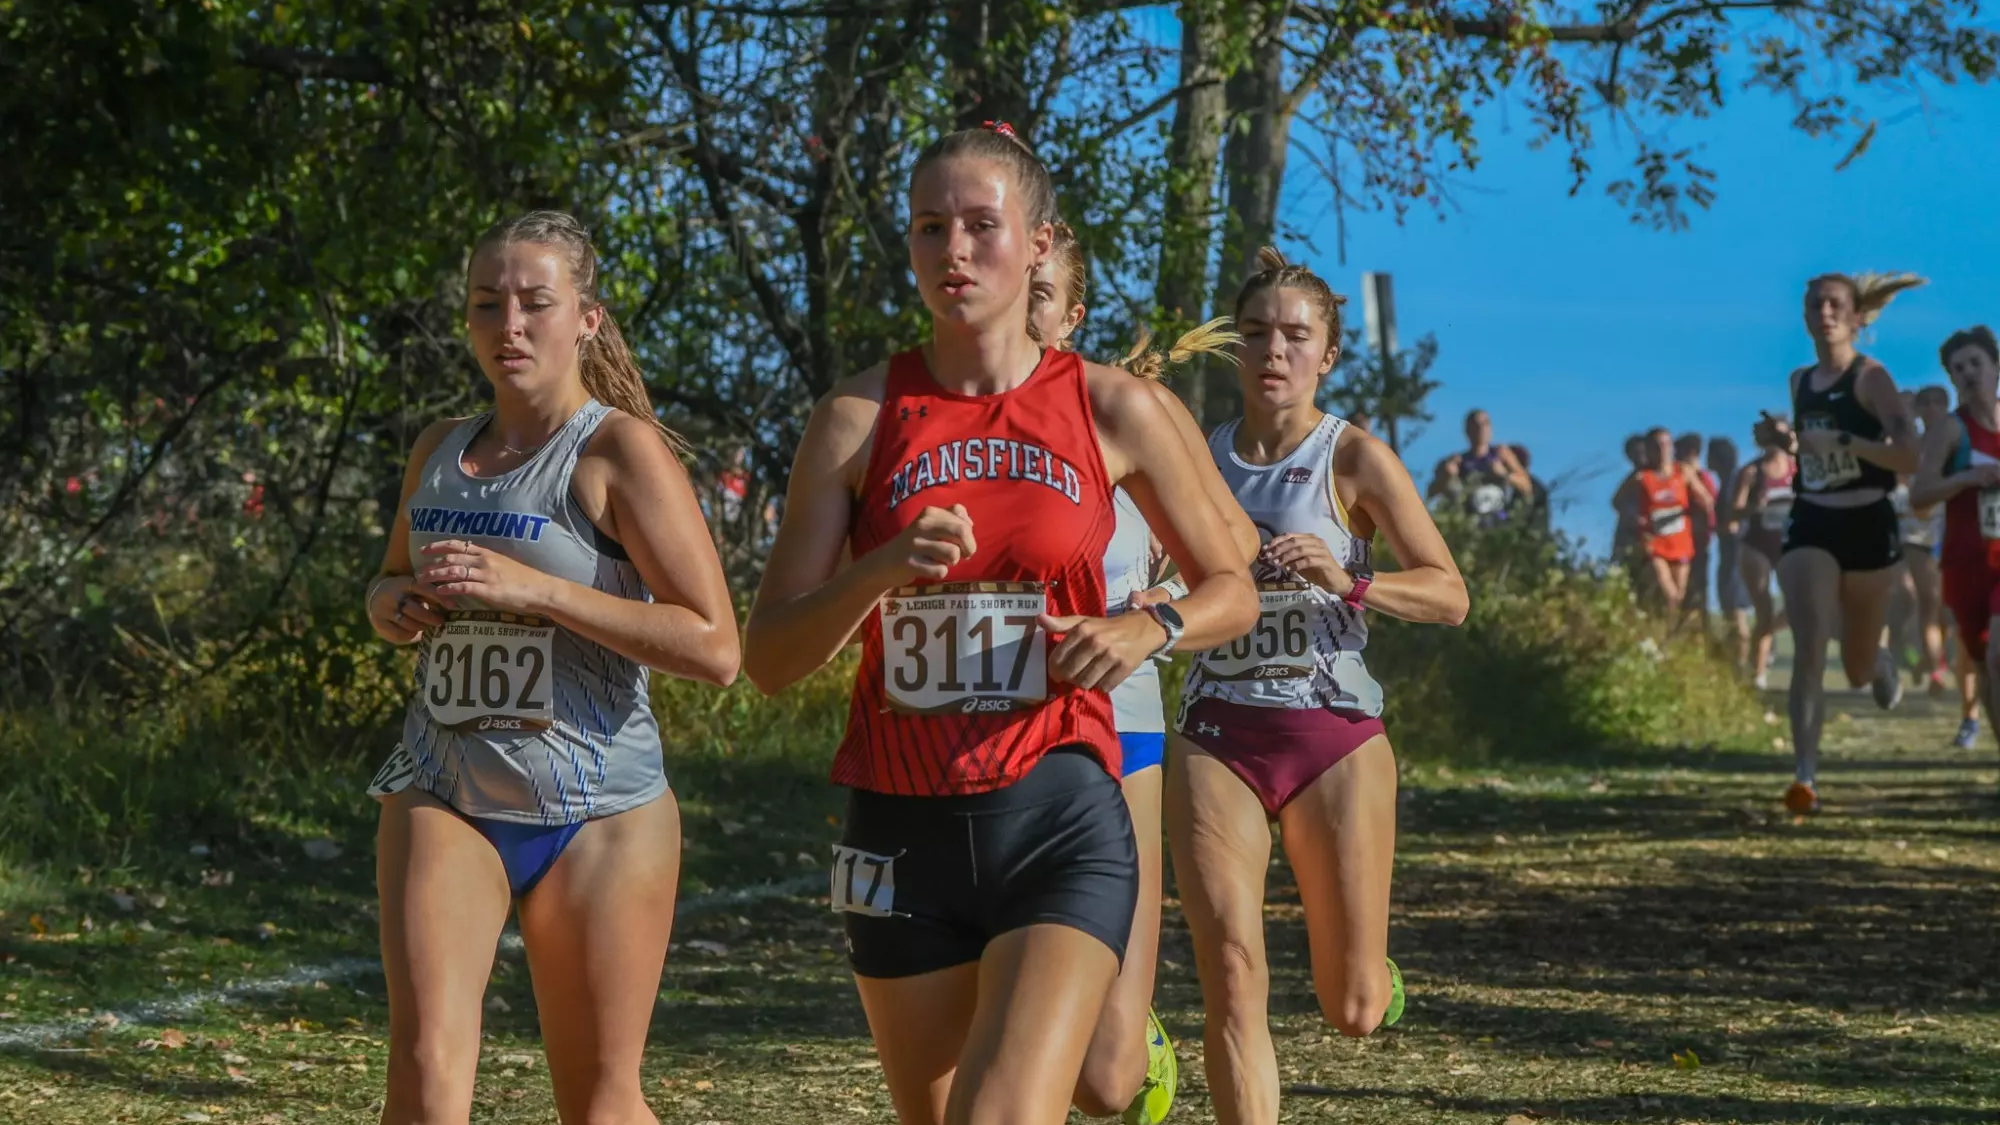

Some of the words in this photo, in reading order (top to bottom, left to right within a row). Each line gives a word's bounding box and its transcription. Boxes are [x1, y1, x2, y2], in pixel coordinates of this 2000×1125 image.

[889, 437, 1082, 512] MANSFIELD
[446, 625, 470, 635] LEHIGH
[473, 626, 495, 636] PAUL
[497, 627, 525, 637] SHORT
[528, 629, 548, 638] RUN
[906, 600, 945, 611] LEHIGH
[950, 599, 977, 610] PAUL
[980, 599, 1014, 609] SHORT
[1017, 599, 1039, 609] RUN
[892, 615, 1042, 693] 3117
[1208, 608, 1307, 661] 056
[430, 643, 545, 710] 3162
[372, 747, 414, 793] 62
